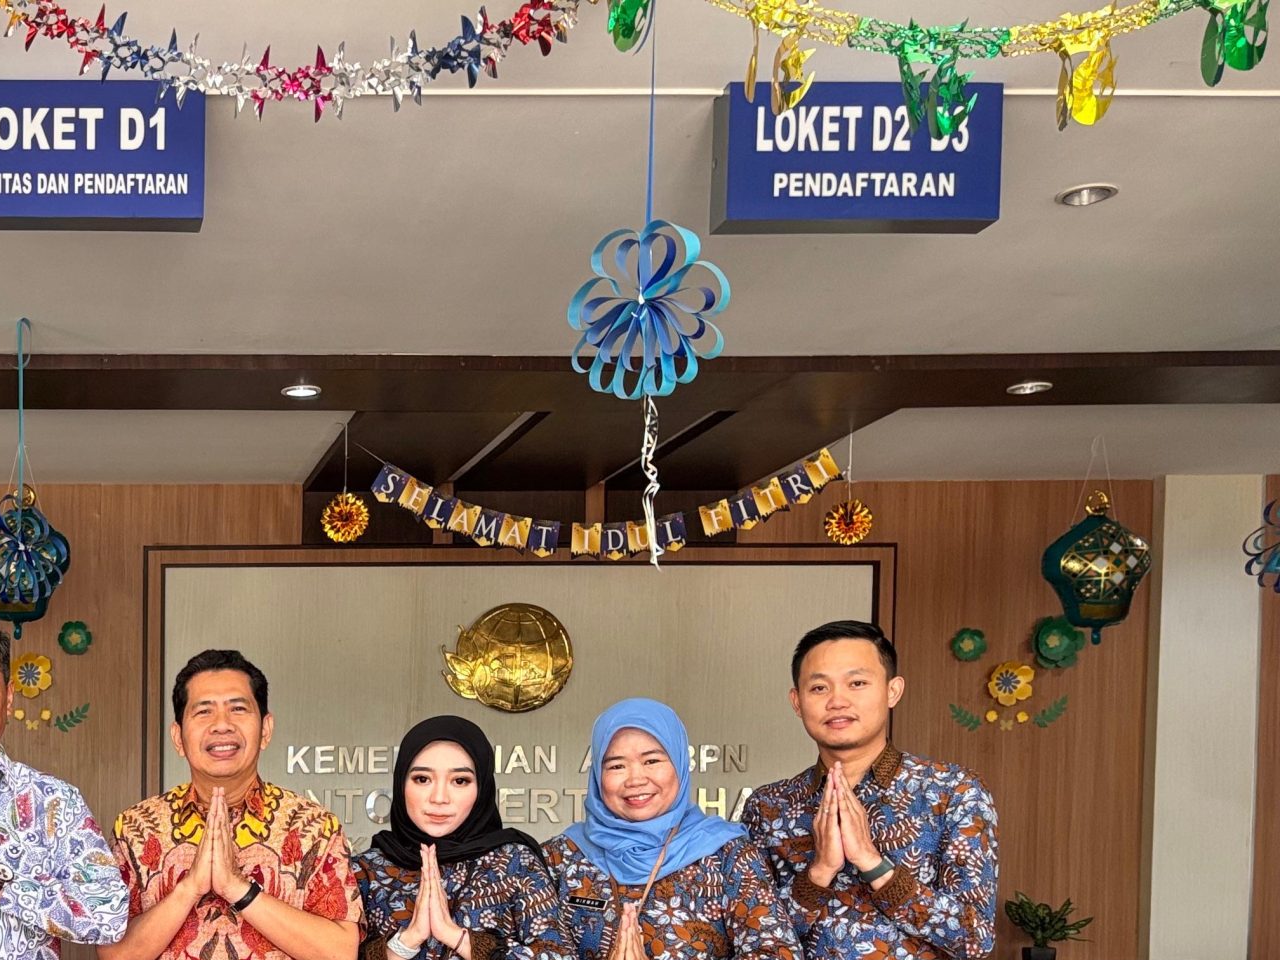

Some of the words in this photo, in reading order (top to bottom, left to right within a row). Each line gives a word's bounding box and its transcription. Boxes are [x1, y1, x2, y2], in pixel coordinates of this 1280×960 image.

[120, 107, 166, 151] D1
[756, 105, 863, 152] LOKET
[872, 105, 911, 152] D2
[37, 173, 69, 195] DAN
[74, 173, 188, 195] PENDAFTARAN
[773, 172, 956, 198] PENDAFTARAN
[381, 473, 552, 548] SELAMAT
[582, 520, 682, 550] IDUL
[709, 459, 831, 530] FITRI
